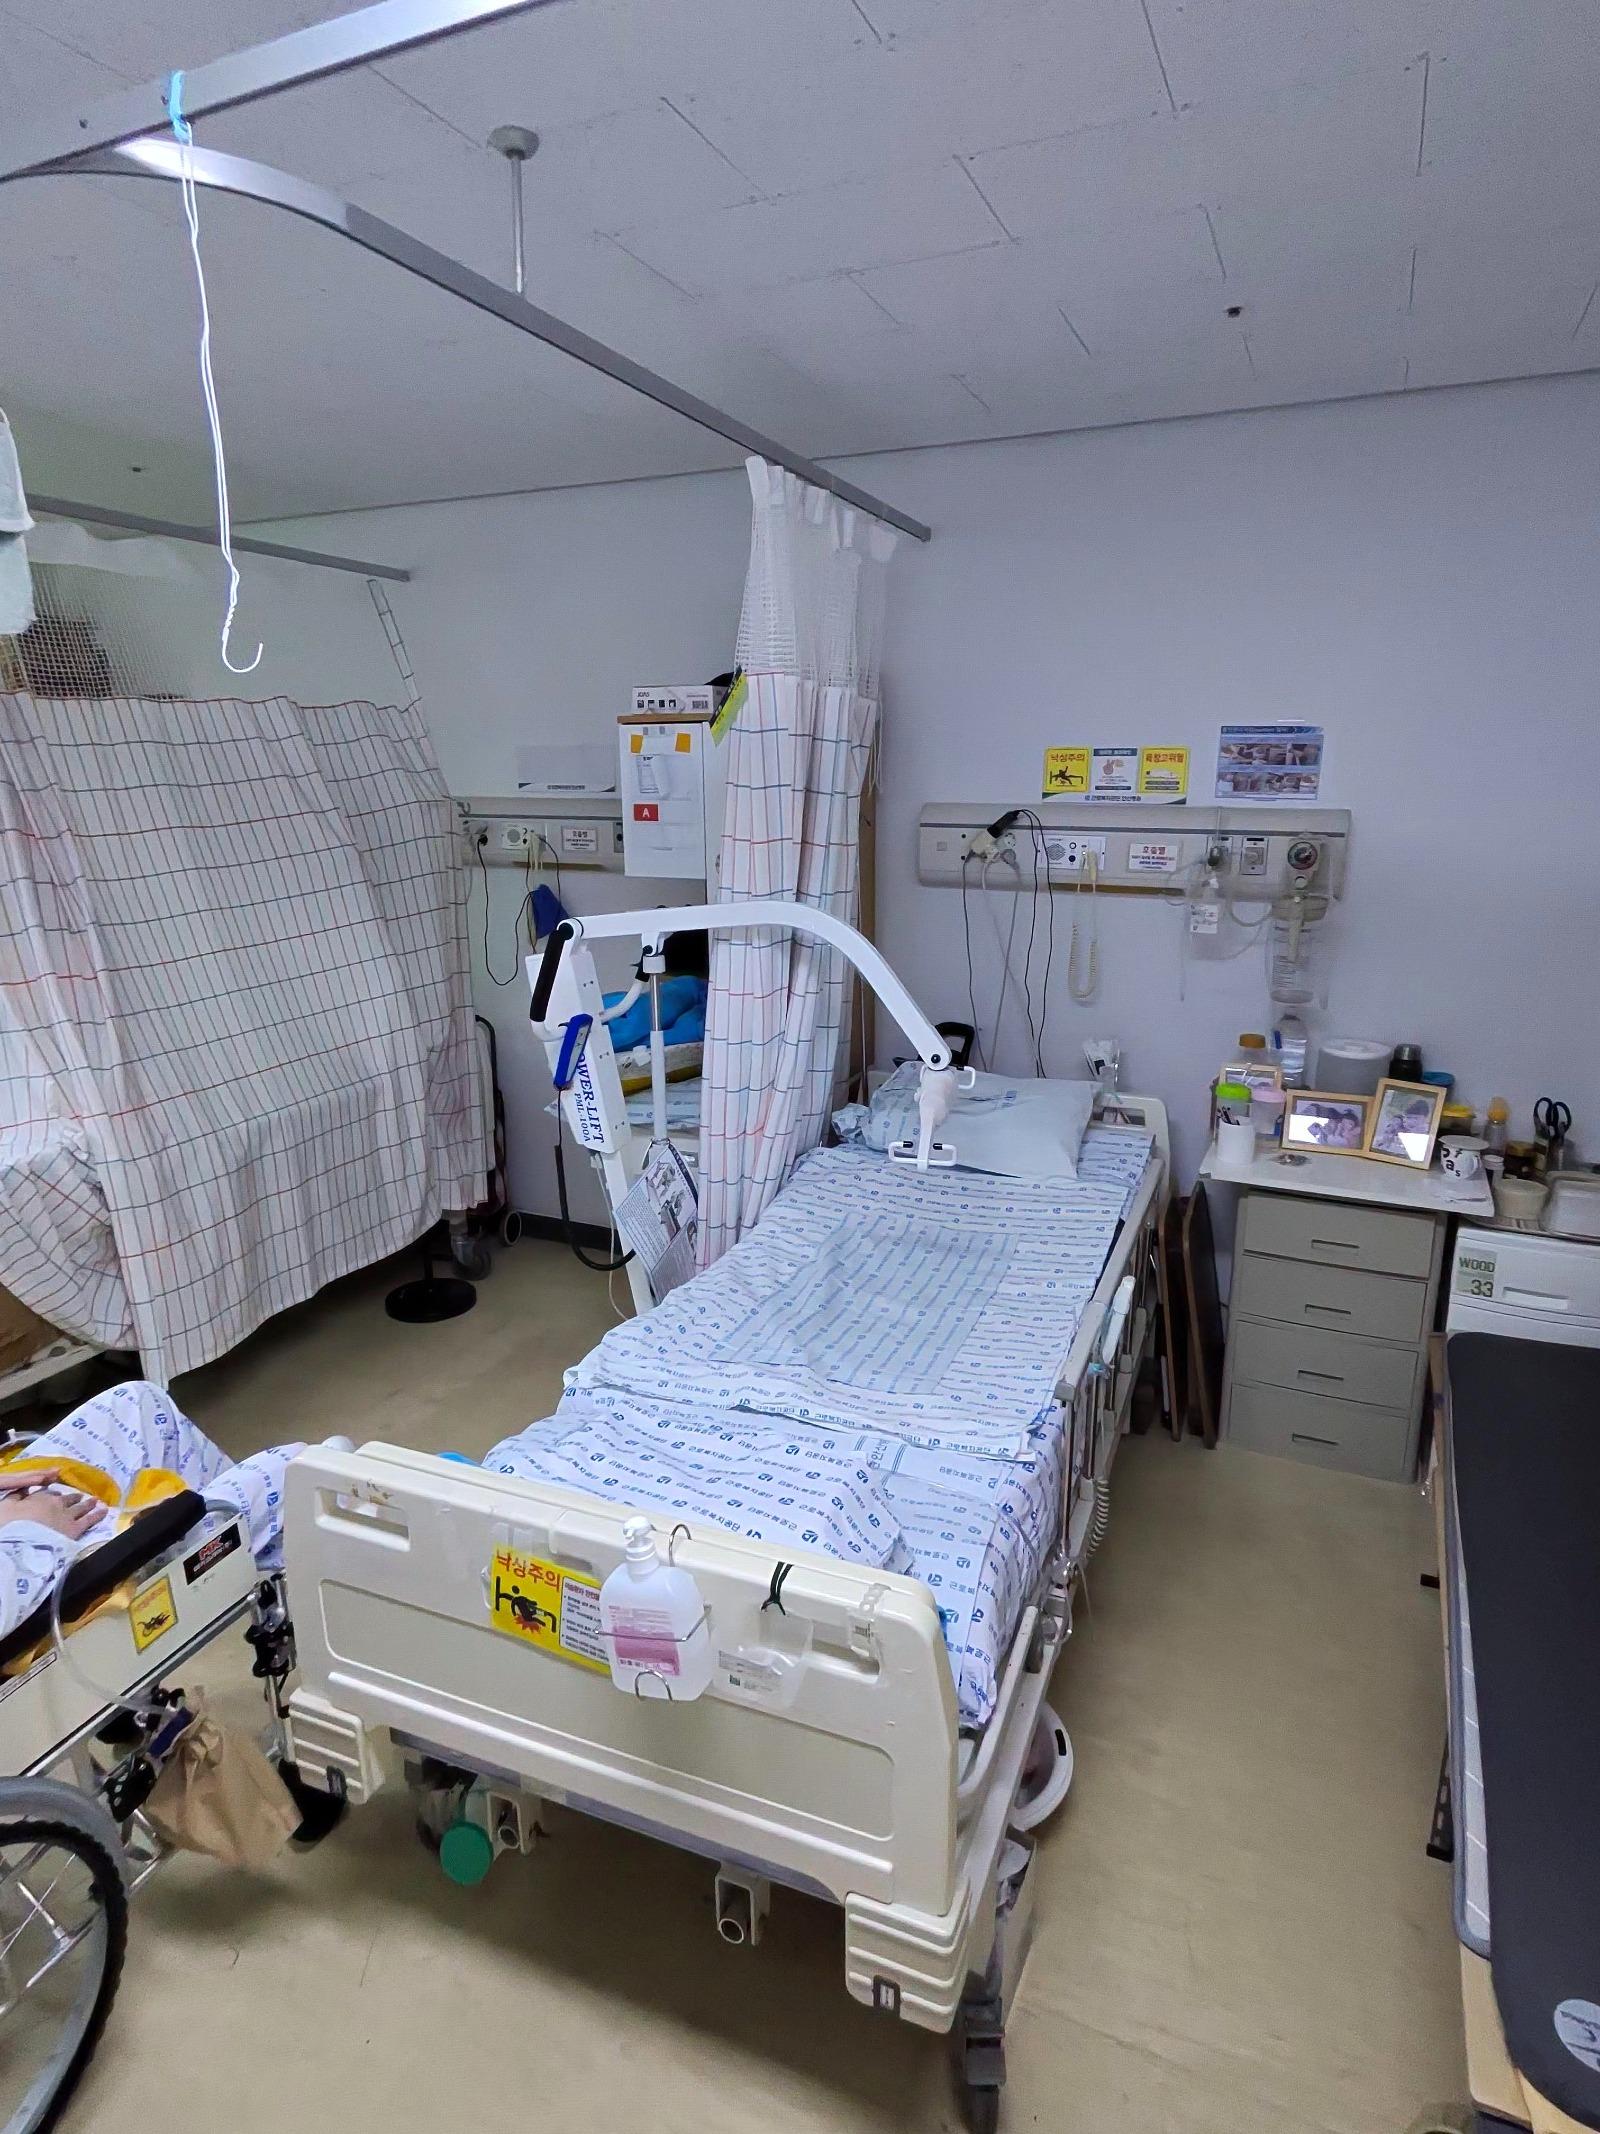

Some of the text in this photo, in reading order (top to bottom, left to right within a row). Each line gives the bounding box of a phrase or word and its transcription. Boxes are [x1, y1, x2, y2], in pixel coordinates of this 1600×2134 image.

[642, 807, 651, 818] A
[576, 1052, 605, 1143] OWER-LIFT
[1458, 1256, 1495, 1273] WOOD
[1470, 1279, 1494, 1298] 33
[496, 1548, 561, 1593] 낙상주의
